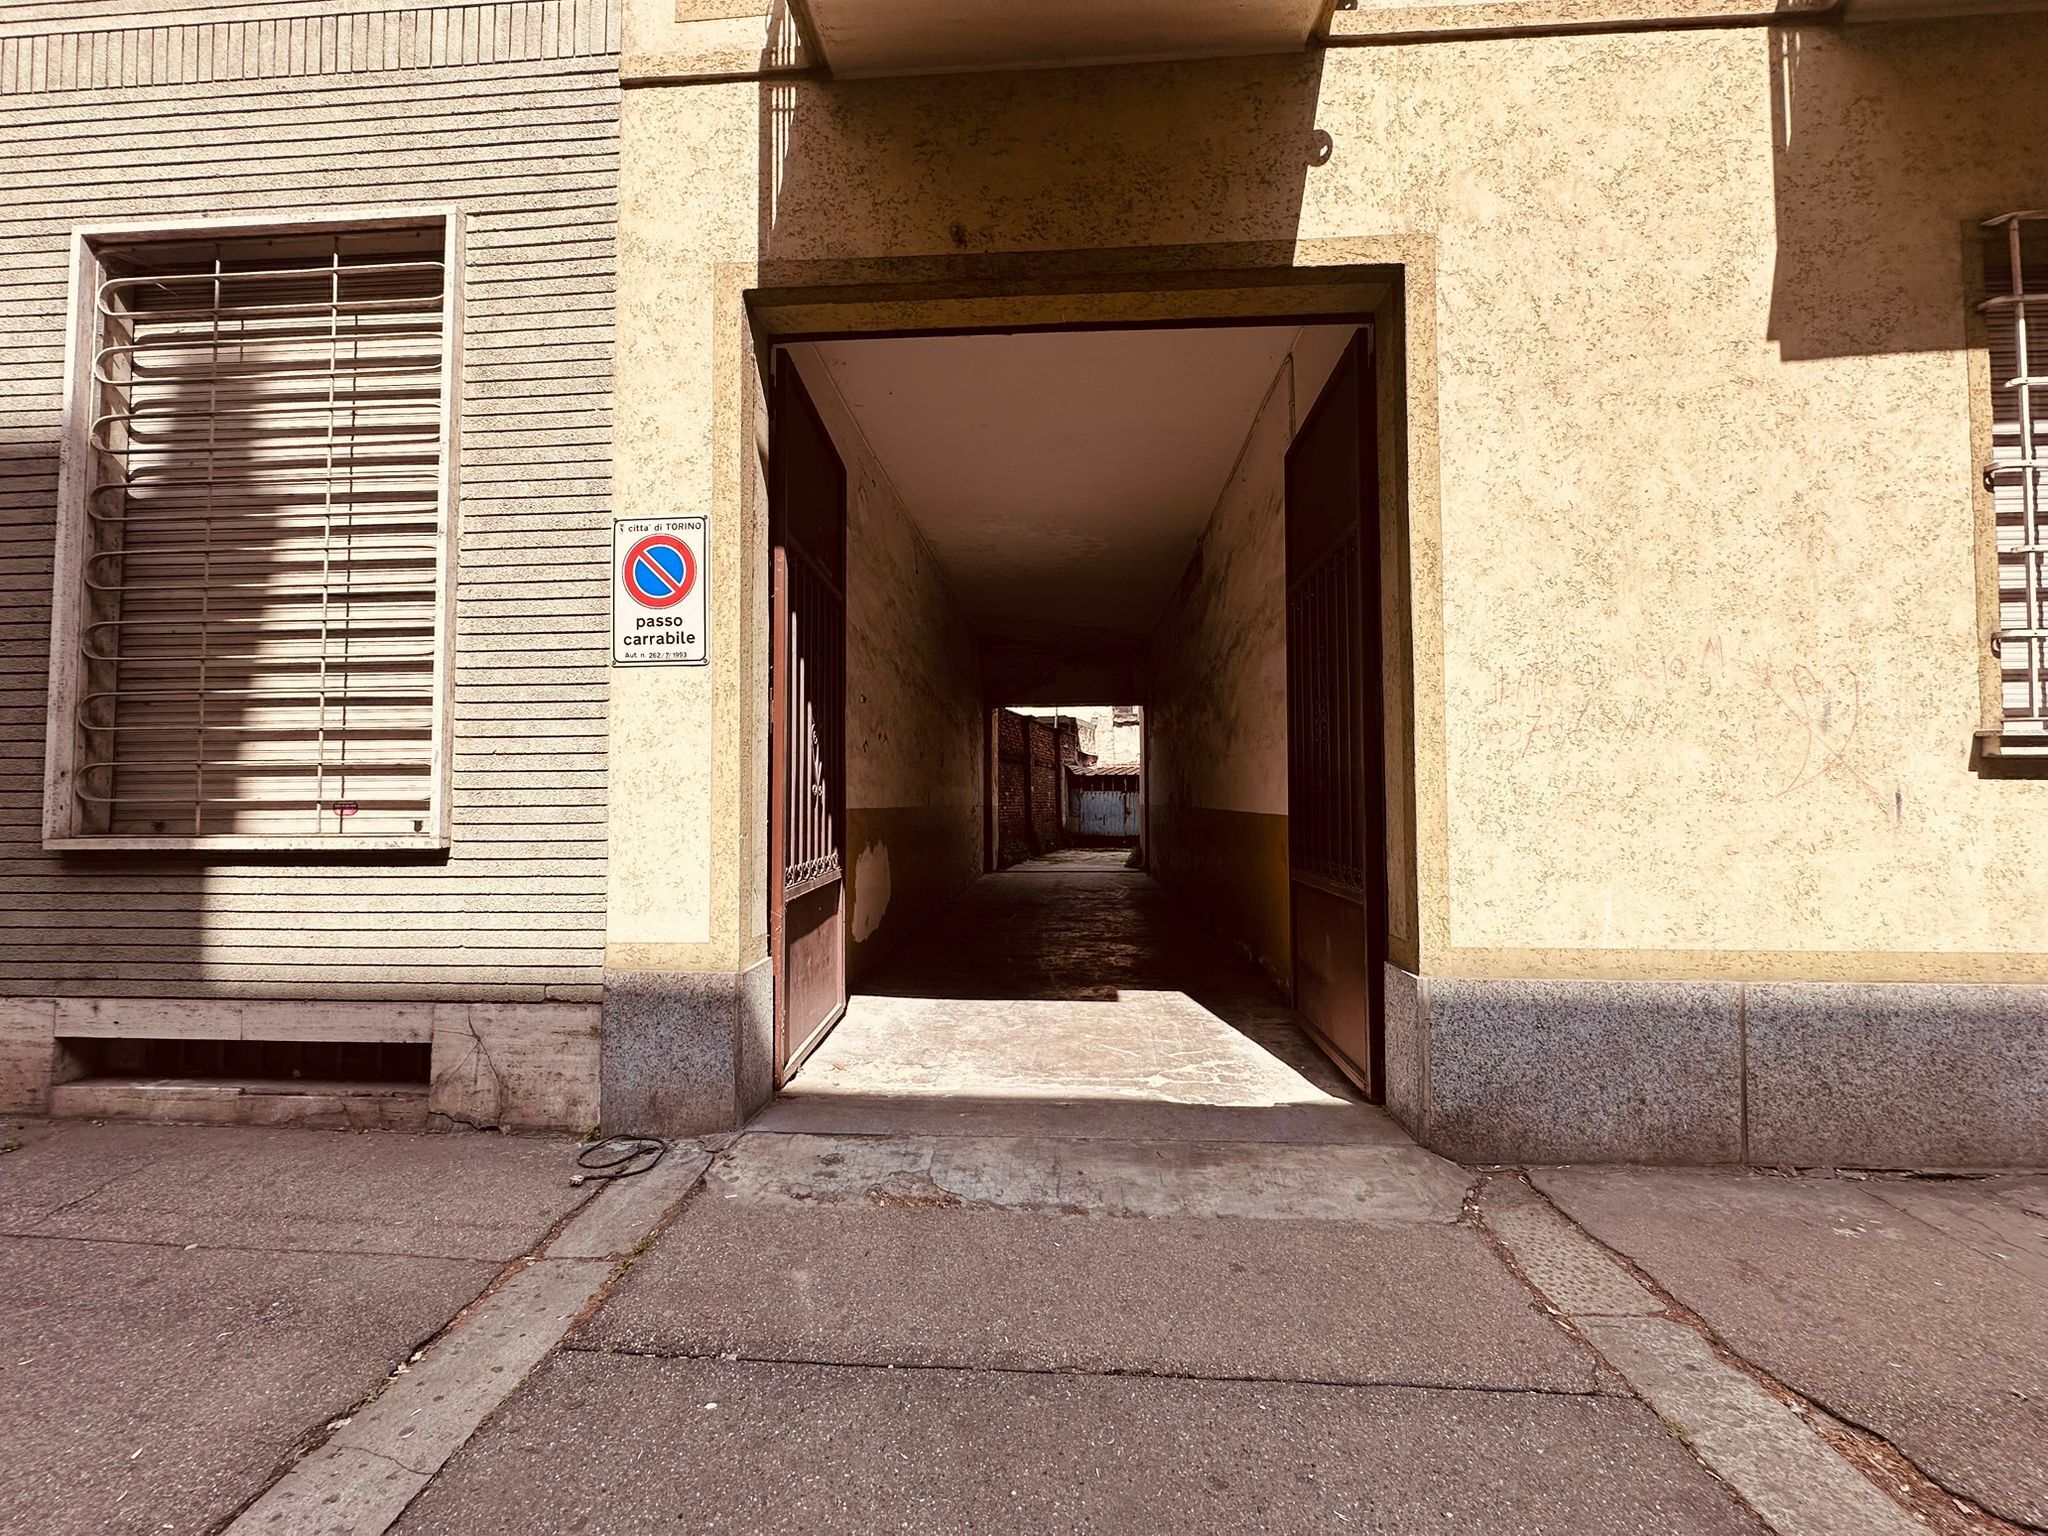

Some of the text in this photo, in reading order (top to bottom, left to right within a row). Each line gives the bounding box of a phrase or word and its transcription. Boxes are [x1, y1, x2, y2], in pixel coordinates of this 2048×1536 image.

[654, 523, 663, 531] di
[666, 522, 702, 531] TORINO
[636, 616, 683, 630] passo
[623, 631, 696, 646] carrabile
